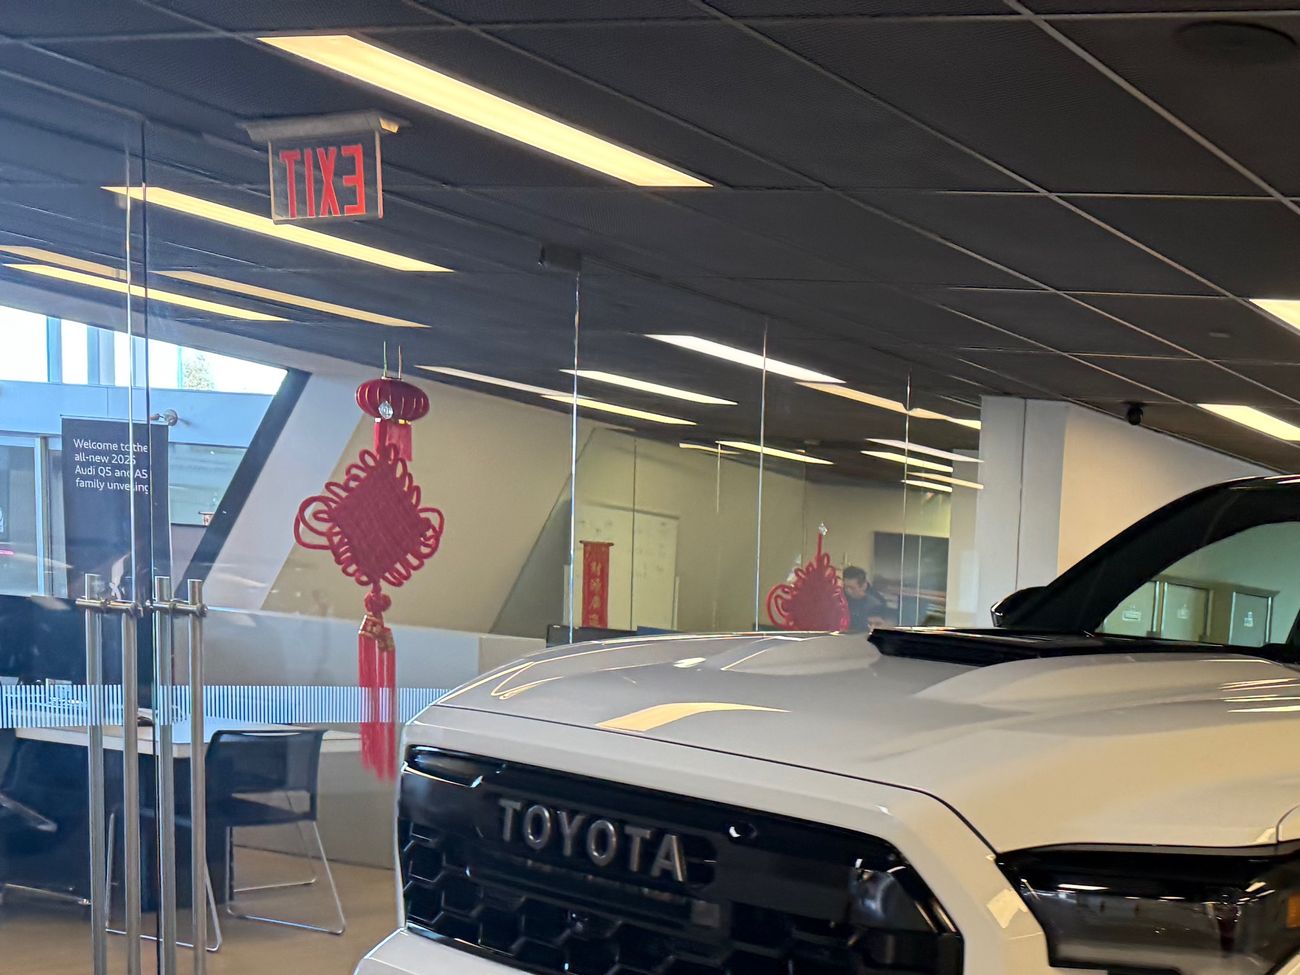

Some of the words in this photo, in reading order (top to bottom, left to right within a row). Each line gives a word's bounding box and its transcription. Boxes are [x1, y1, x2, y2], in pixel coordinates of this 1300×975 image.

[73, 438, 118, 451] Welcome
[133, 443, 148, 453] the
[74, 453, 109, 464] all-new
[75, 465, 96, 475] Audi
[75, 478, 105, 491] family
[107, 482, 149, 495] unveing
[498, 798, 687, 882] TOYOTA
